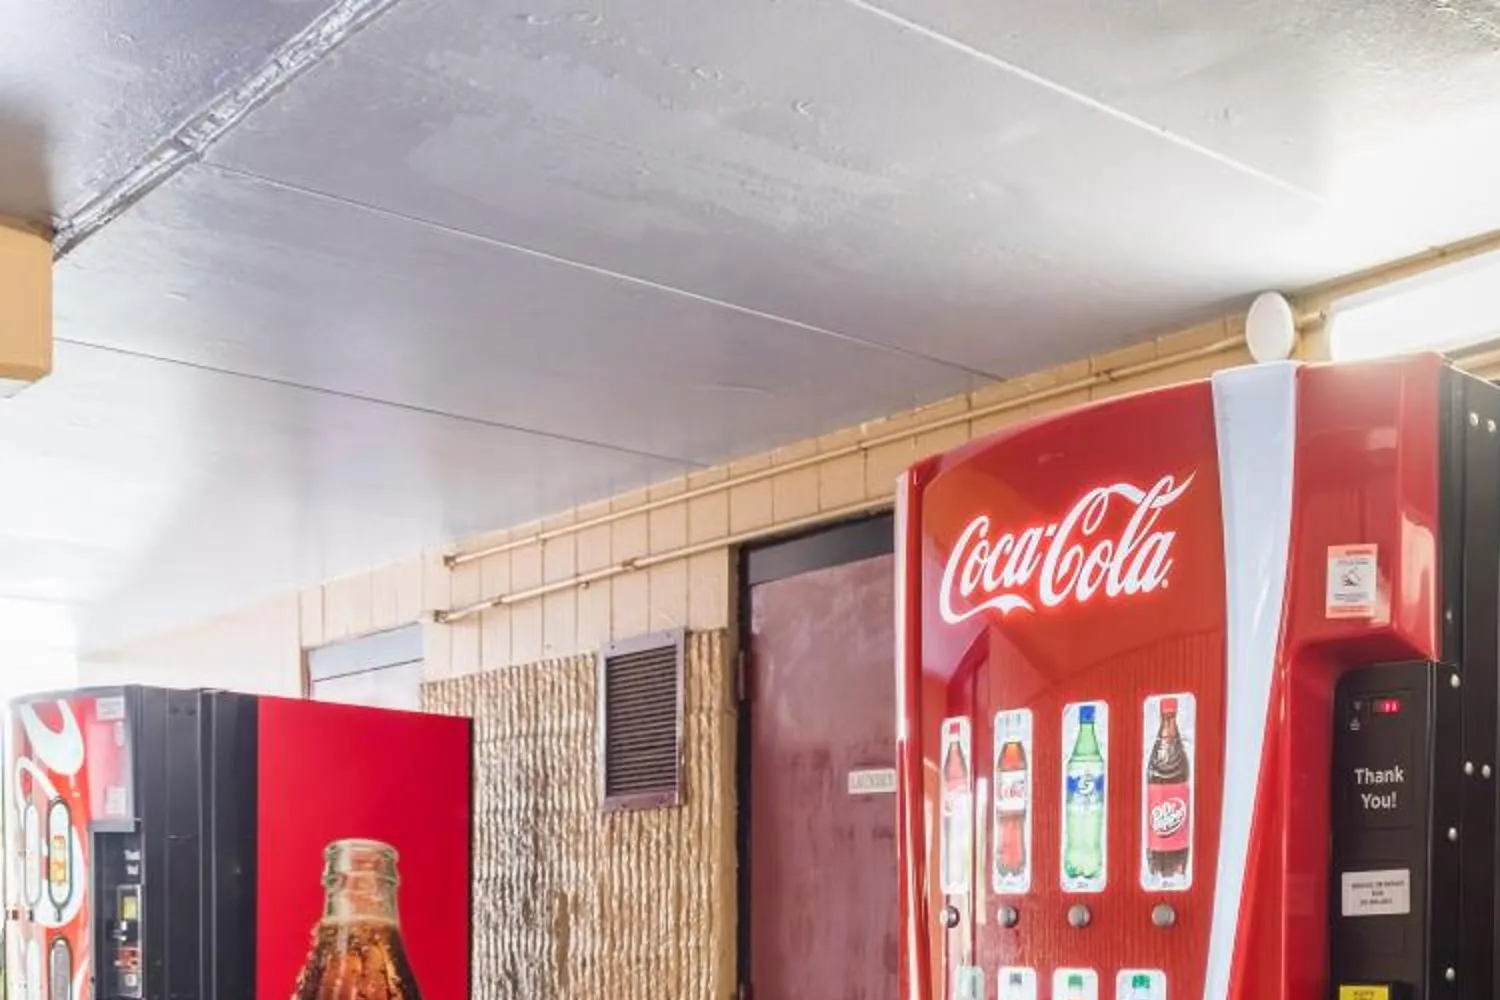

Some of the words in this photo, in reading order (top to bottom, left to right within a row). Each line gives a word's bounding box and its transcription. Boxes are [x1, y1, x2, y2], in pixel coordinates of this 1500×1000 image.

[939, 463, 1199, 625] Coca-Cola
[1354, 765, 1405, 784] Thank
[1360, 791, 1398, 810] You!
